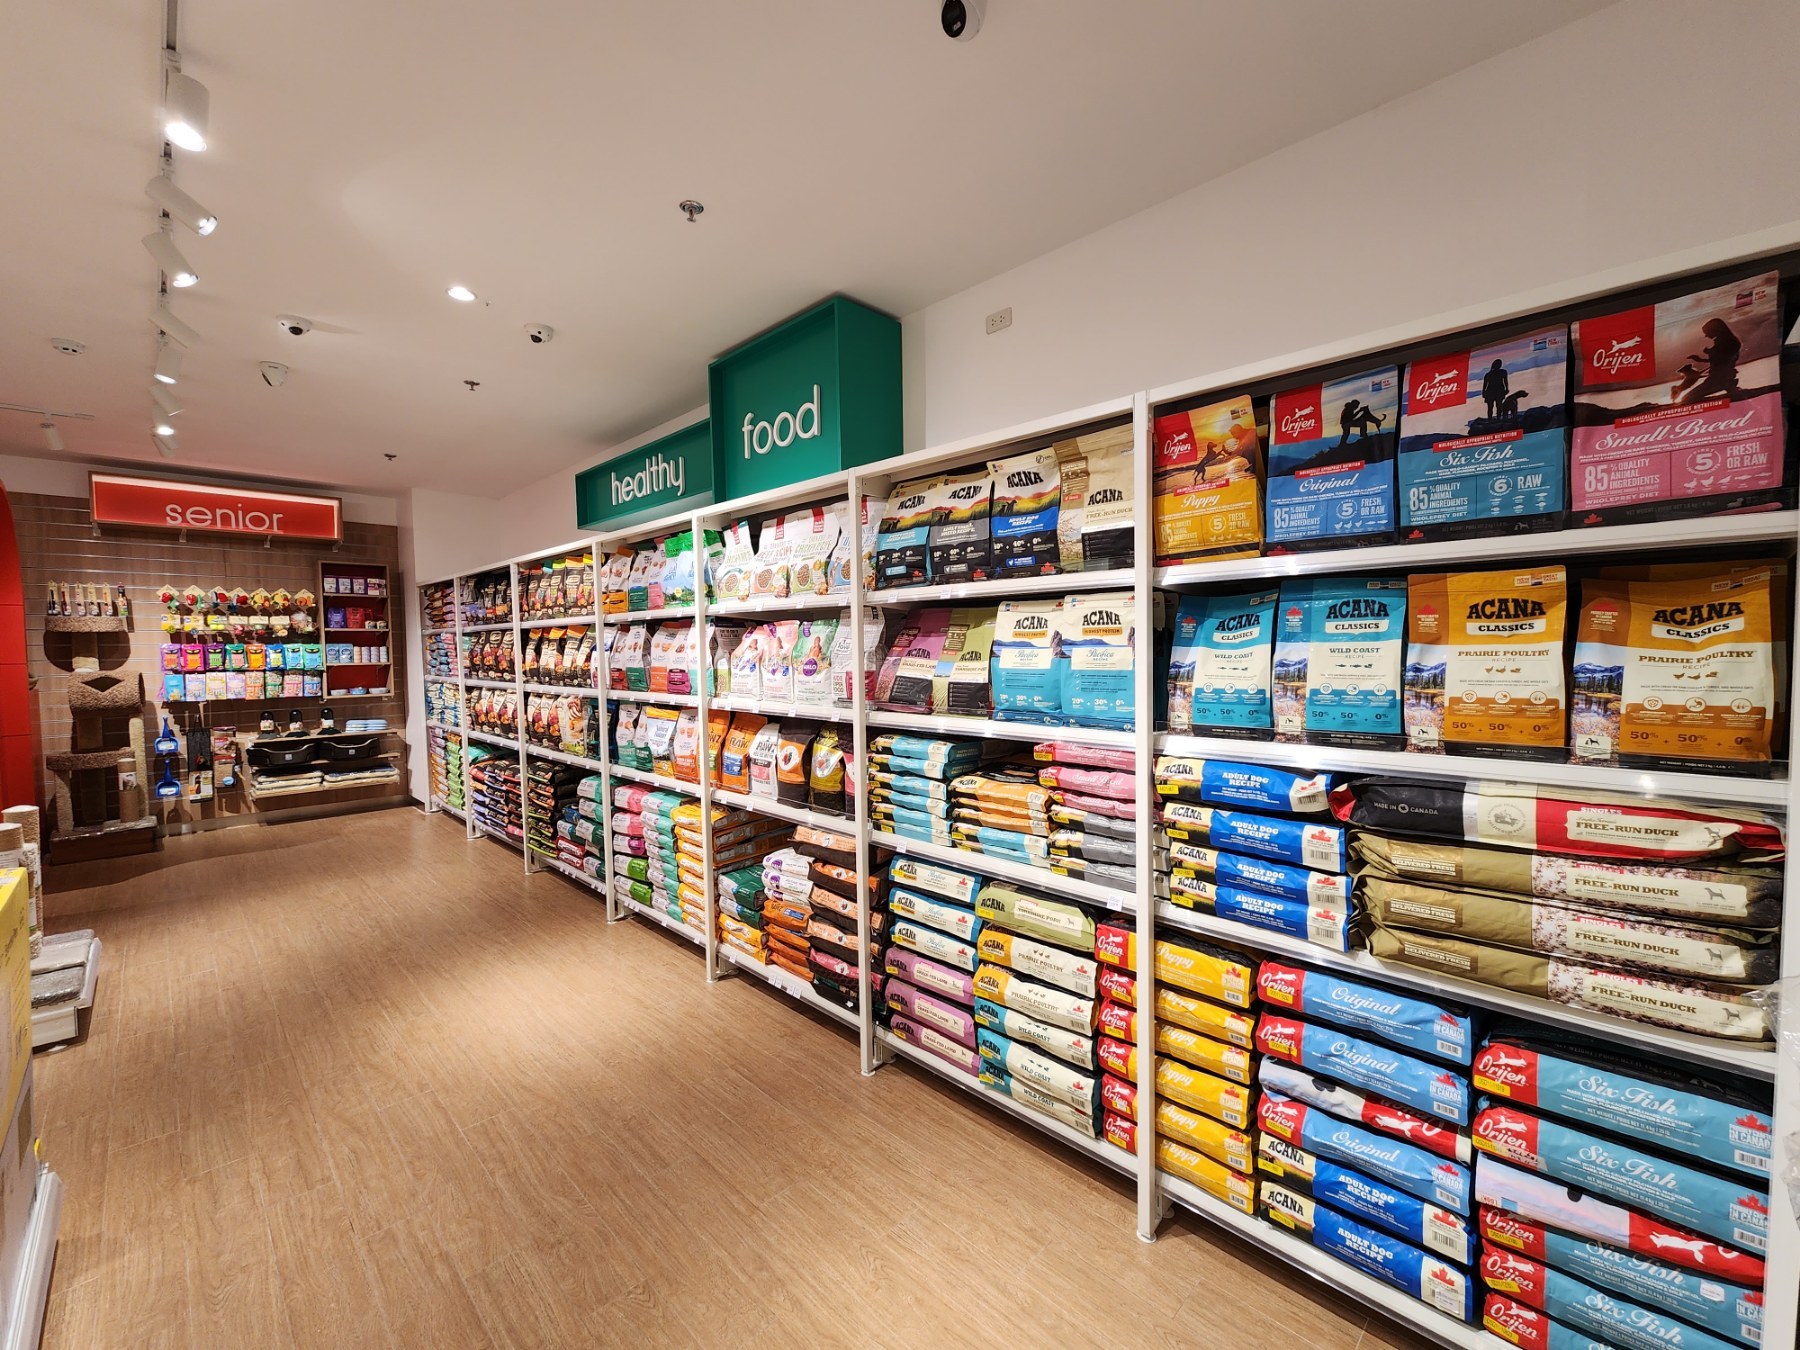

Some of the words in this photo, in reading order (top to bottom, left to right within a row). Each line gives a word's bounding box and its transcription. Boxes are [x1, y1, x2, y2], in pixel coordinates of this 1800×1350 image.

[1593, 349, 1642, 375] Orijen
[1416, 381, 1457, 404] Orijen
[1622, 412, 1656, 424] BIOLOGICALLY
[1658, 405, 1692, 418] APPROPRIATE
[1694, 400, 1723, 411] NUTRITION
[742, 384, 821, 459] food
[1282, 415, 1315, 438] Orijen
[1595, 425, 1664, 451] Small
[1669, 410, 1755, 440] Breed
[1164, 440, 1191, 460] Orijen
[1439, 451, 1470, 468] Six
[1471, 445, 1514, 463] Fish
[1727, 441, 1760, 457] FRESH
[1618, 458, 1650, 469] QUALITY
[1694, 454, 1713, 470] 5
[1727, 457, 1742, 468] OR
[1743, 453, 1768, 467] RAW
[611, 453, 685, 506] healthy
[1006, 471, 1044, 488] ACANA
[1517, 474, 1542, 489] RAW
[1584, 465, 1608, 493] 85
[1610, 468, 1640, 478] ANIMAL
[1299, 473, 1359, 494] Original
[1435, 482, 1461, 491] QUALITY
[1493, 479, 1508, 493] 6
[1609, 476, 1660, 489] INGREDIENTS
[1087, 488, 1123, 506] ACANA
[1181, 494, 1220, 509] Puppy
[1361, 497, 1381, 506] FRESH
[1409, 486, 1428, 511] 85
[1429, 498, 1468, 509] INGREDIENTS
[1430, 490, 1453, 500] ANIMAL
[1585, 494, 1637, 505] WHOLEPREY
[1639, 492, 1659, 500] DIET
[165, 503, 284, 533] senior
[1274, 507, 1290, 529] 85
[1341, 502, 1353, 516] 5
[1370, 505, 1385, 515] RAW
[1213, 518, 1222, 530] 5
[1289, 518, 1321, 527] INGREDIENTS
[1082, 610, 1122, 626] ACANA
[1325, 599, 1390, 620] ACANA
[1465, 598, 1547, 620] ACANA
[1651, 602, 1745, 627] ACANA
[1013, 616, 1049, 630] ACANA
[1214, 613, 1261, 632] ACANA
[1334, 622, 1380, 631] CLASSICS
[1478, 622, 1535, 632] CLASSICS
[1666, 622, 1731, 639] CLASSICS
[1221, 630, 1254, 641] CLASSICS
[905, 648, 931, 659] ACANA
[960, 650, 982, 661] ACANA
[1234, 652, 1253, 660] COAST
[1503, 649, 1550, 657] POULTRY
[1638, 655, 1694, 664] PRAIRIE
[1697, 650, 1755, 663] POULTRY
[1682, 662, 1711, 670] RECIPE
[1163, 763, 1194, 775] ACANA
[1222, 772, 1249, 780] ADULT
[1249, 774, 1270, 784] DOG
[1229, 779, 1261, 789] RECIPE
[1171, 806, 1203, 820] ACANA
[1374, 802, 1389, 810] MADE
[1410, 806, 1438, 815] CANADA
[1580, 807, 1622, 815] SINGLES
[1231, 820, 1258, 832] ADULT
[1259, 825, 1279, 835] DOG
[1237, 828, 1271, 840] RECIPE
[1576, 821, 1642, 836] FREE-RUN
[1644, 828, 1679, 837] DUCK
[1176, 846, 1208, 862] ACANA
[898, 864, 918, 876] ACANA
[1236, 863, 1264, 875] ADULT
[1265, 869, 1285, 880] DOG
[1431, 862, 1456, 872] FRESH
[1177, 876, 1207, 894] ACANA
[1242, 871, 1277, 884] RECIPE
[1574, 878, 1641, 893] FREE-RUN
[1642, 887, 1680, 897] DUCK
[897, 896, 916, 908] ACANA
[980, 898, 1006, 912] ACANA
[1235, 894, 1263, 907] ADULT
[1264, 900, 1284, 911] DOG
[1242, 902, 1275, 915] RECIPE
[1390, 902, 1431, 914] DELIVERED
[1431, 909, 1456, 919] FRESH
[1580, 917, 1622, 928] SINGLES
[898, 928, 917, 940] ACANA
[982, 939, 1005, 952] ACANA
[1097, 936, 1123, 956] Orijen
[1575, 932, 1641, 949] FREE-RUN
[1643, 943, 1680, 956] DUCK
[1157, 945, 1195, 970] Puppy
[1404, 946, 1446, 960] DELIVERED
[1446, 955, 1471, 966] FRESH
[978, 975, 1000, 989] ACANA
[1101, 974, 1127, 993] Orijen
[1261, 972, 1295, 994] Orijen
[1160, 988, 1198, 1012] Puppy
[1331, 986, 1402, 1016] Original
[1591, 985, 1658, 1005] FREE-RUN
[1659, 1000, 1697, 1014] DUCK
[1101, 1010, 1127, 1029] Orijen
[1161, 1025, 1197, 1049] Puppy
[1261, 1025, 1295, 1047] Orijen
[1099, 1044, 1124, 1064] Orijen
[1329, 1040, 1399, 1075] Original
[1159, 1062, 1194, 1087] Puppy
[1478, 1055, 1527, 1085] Orijen
[1103, 1084, 1128, 1106] Orijen
[1578, 1075, 1619, 1099] Six
[1620, 1087, 1678, 1115] Fish
[1161, 1104, 1198, 1130] Puppy
[1261, 1103, 1295, 1129] Orijen
[1105, 1120, 1130, 1142] Orijen
[1478, 1118, 1527, 1150] Orijen
[1162, 1141, 1199, 1167] Puppy
[1268, 1140, 1304, 1166] ACANA
[1332, 1131, 1400, 1162] Original
[1578, 1145, 1619, 1169] Six
[1620, 1157, 1678, 1187] Fish
[1338, 1173, 1370, 1193] ADULT
[1371, 1189, 1395, 1204] DOG
[1346, 1184, 1385, 1207] RECIPE
[1268, 1190, 1304, 1217] ACANA
[1485, 1210, 1535, 1242] Orijen
[1337, 1227, 1369, 1248] ADULT
[1370, 1243, 1394, 1260] DOG
[1345, 1238, 1384, 1263] RECIPE
[1585, 1240, 1629, 1266] Six
[1629, 1251, 1686, 1286] Fish
[1486, 1255, 1535, 1290] Orijen
[1490, 1303, 1538, 1339] Orijen
[1584, 1292, 1626, 1318] Six
[1627, 1305, 1685, 1344] Fish
